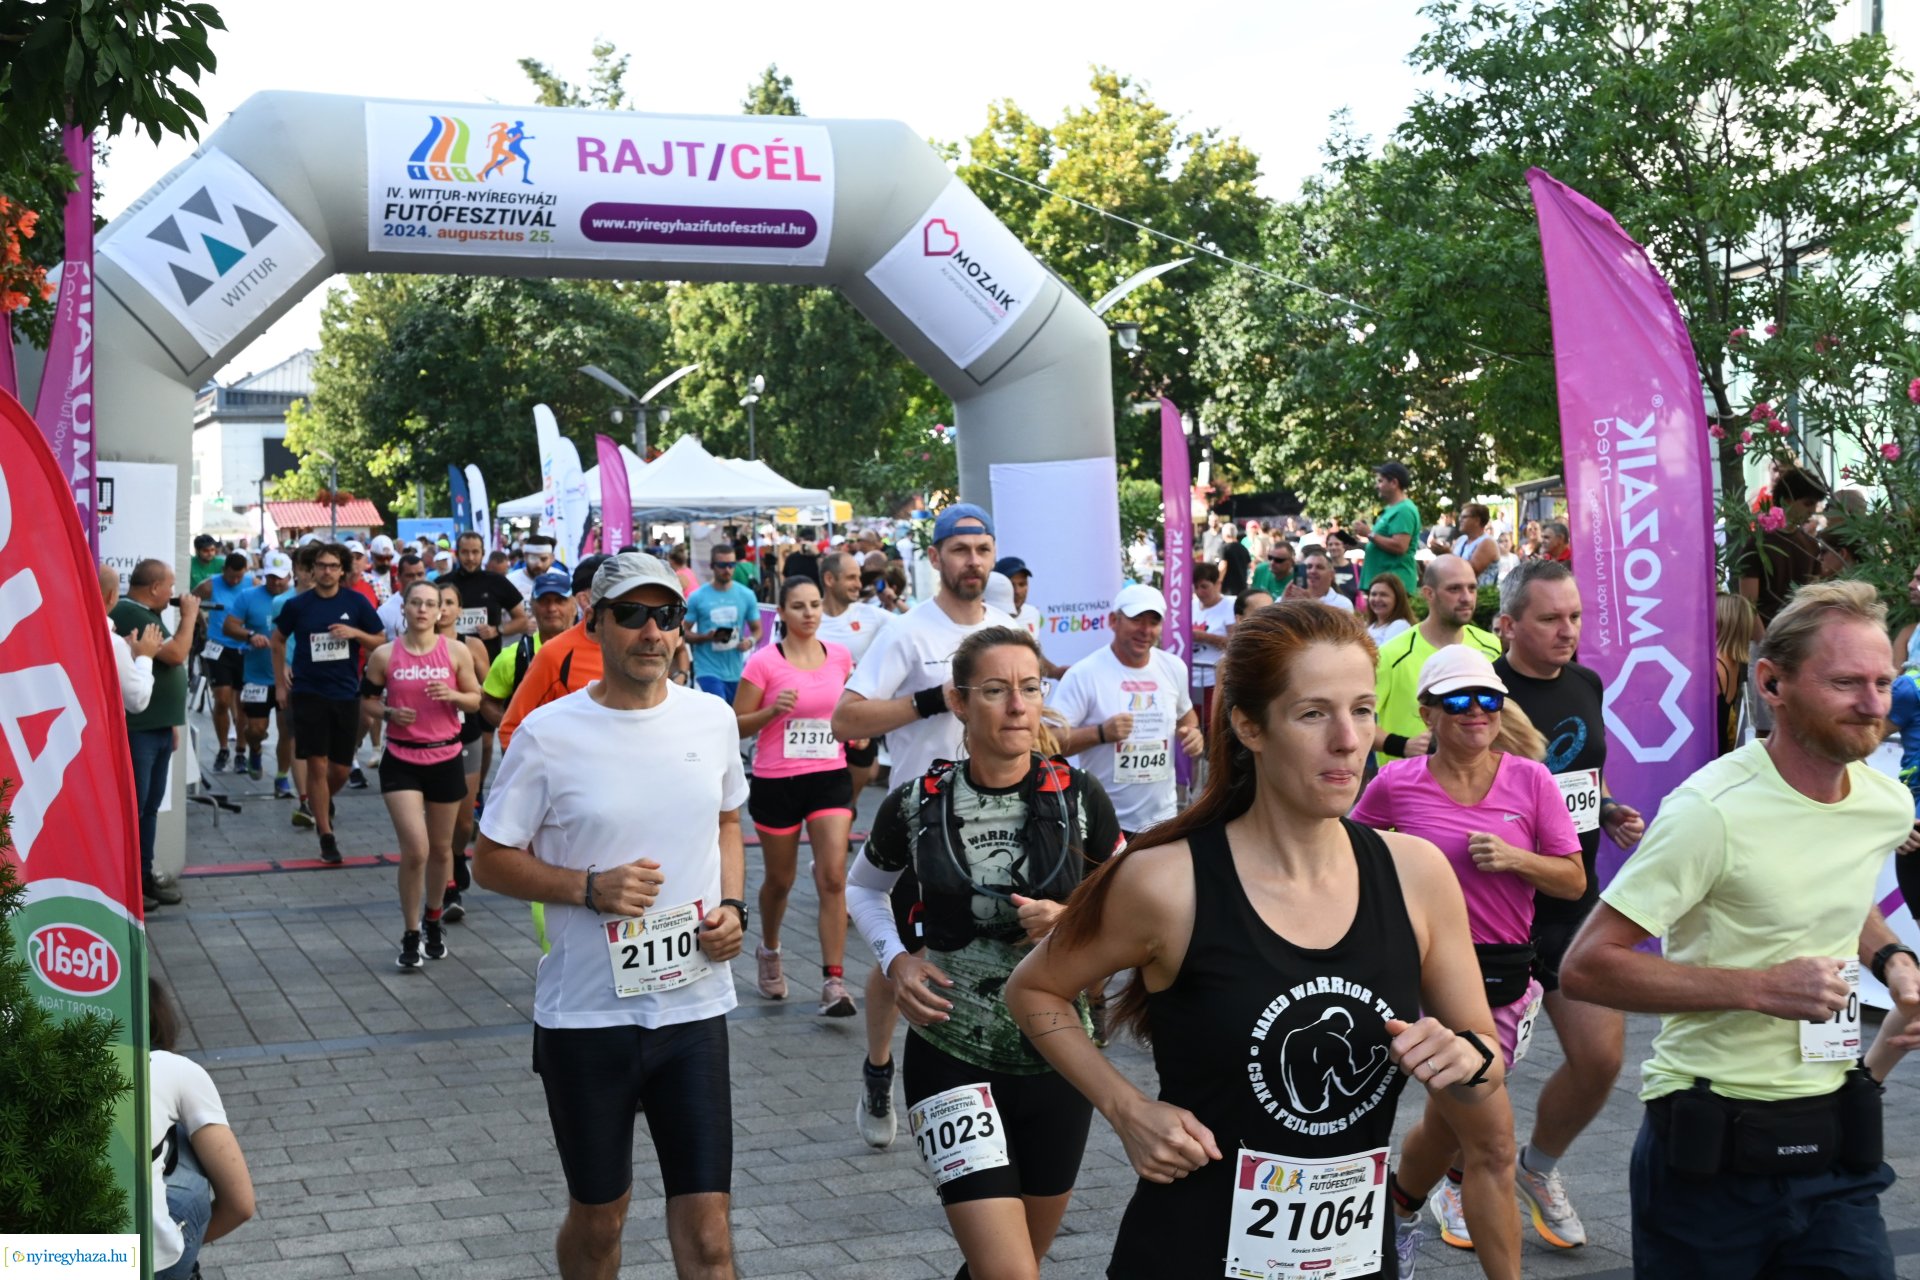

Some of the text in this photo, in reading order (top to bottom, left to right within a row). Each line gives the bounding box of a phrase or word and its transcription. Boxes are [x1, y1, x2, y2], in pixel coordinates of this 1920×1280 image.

[577, 137, 821, 182] RAJT/CÉL
[387, 187, 557, 206] IV. WITTUR-NYÍREGYHÁZI
[384, 200, 557, 227] FUTÓFESZTIVÁL
[384, 223, 554, 242] 2024. augusztus 25.
[592, 216, 806, 236] www.nyiregyhazifutofesztival.hu
[221, 257, 278, 308] WITTUR
[952, 250, 1015, 311] MOZAIK
[1048, 600, 1111, 613] NYÍREGYHÁZA
[456, 616, 485, 625] 21070
[1049, 613, 1105, 633] Többet
[315, 641, 346, 652] 21039
[393, 665, 449, 680] adidas
[789, 732, 834, 744] 21310
[1120, 753, 1166, 768] 21048
[1566, 790, 1596, 813] 096
[1252, 976, 1397, 1040] NAKED WARRIOR TE
[1248, 1063, 1272, 1103] CSAK
[1264, 1101, 1279, 1114] A
[1274, 1108, 1348, 1136] FEJLODES
[917, 1112, 994, 1162] 21023
[1777, 1144, 1818, 1155] KIPRUN
[1309, 1173, 1366, 1191] FUTÓFESZTIVÁL
[1246, 1190, 1375, 1241] 21064
